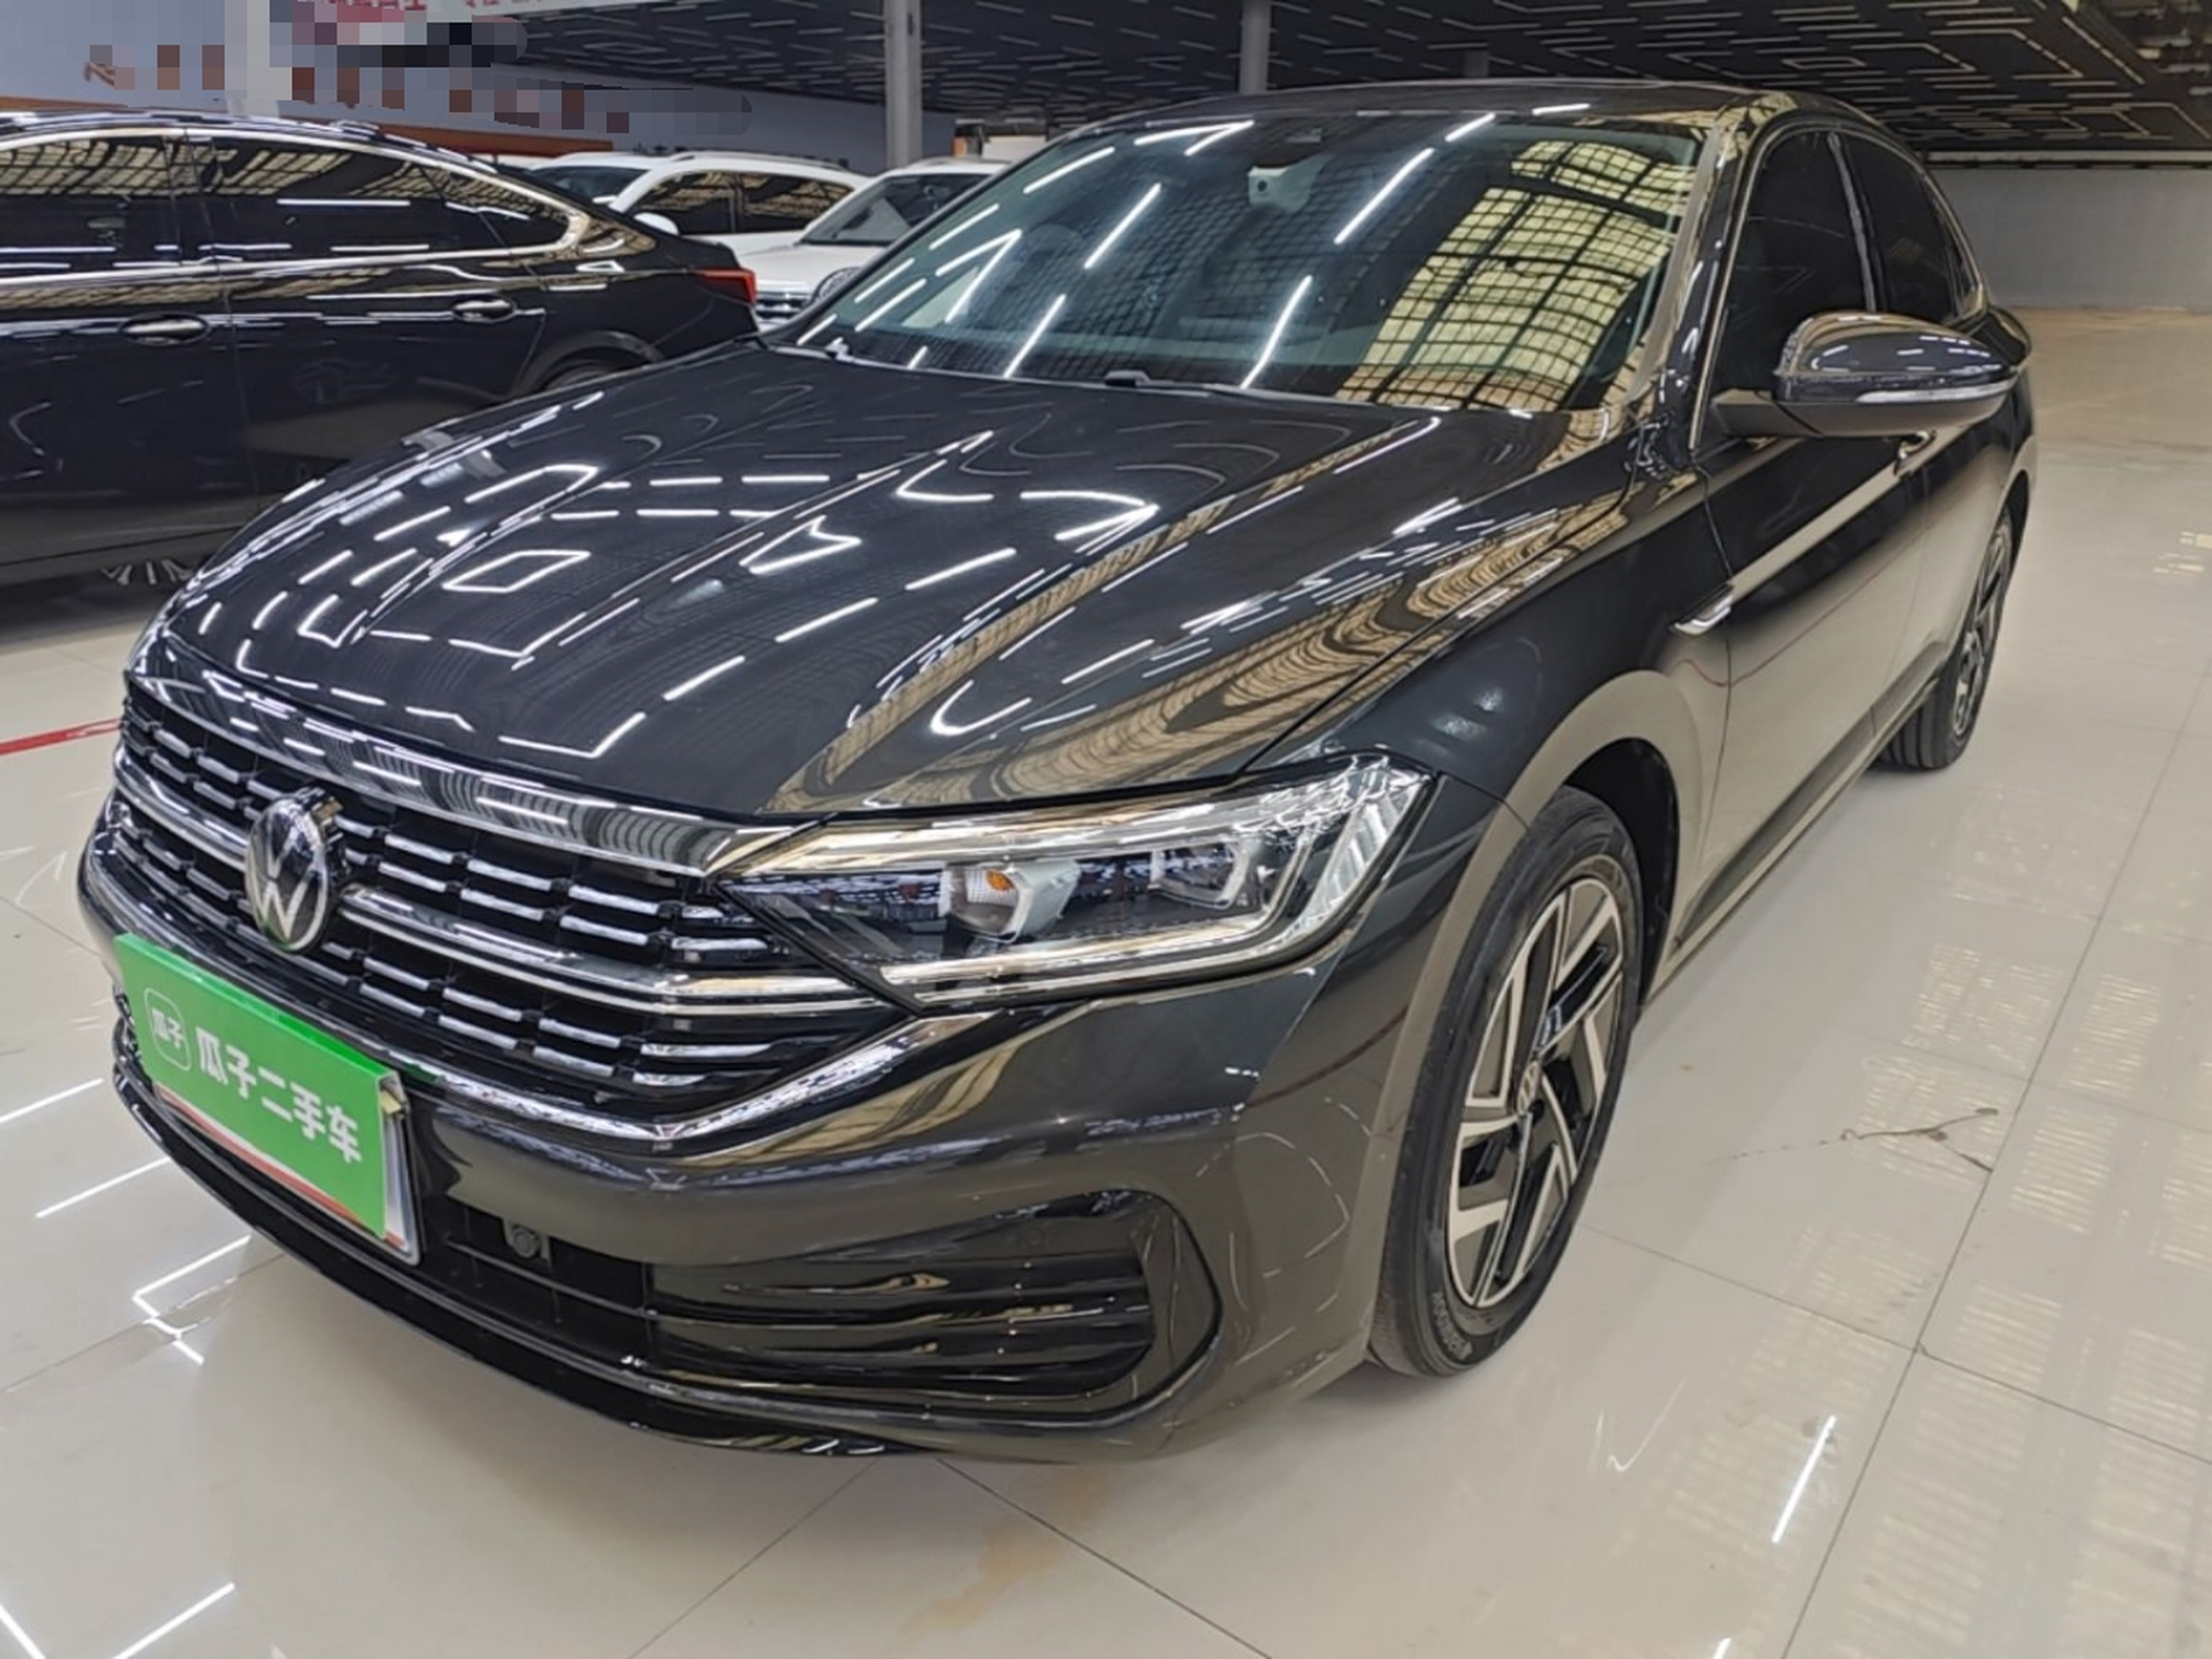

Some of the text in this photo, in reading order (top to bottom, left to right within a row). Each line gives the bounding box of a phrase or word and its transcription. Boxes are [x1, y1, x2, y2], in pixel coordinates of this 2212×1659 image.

[196, 1026, 362, 1164] 瓜子二手车
